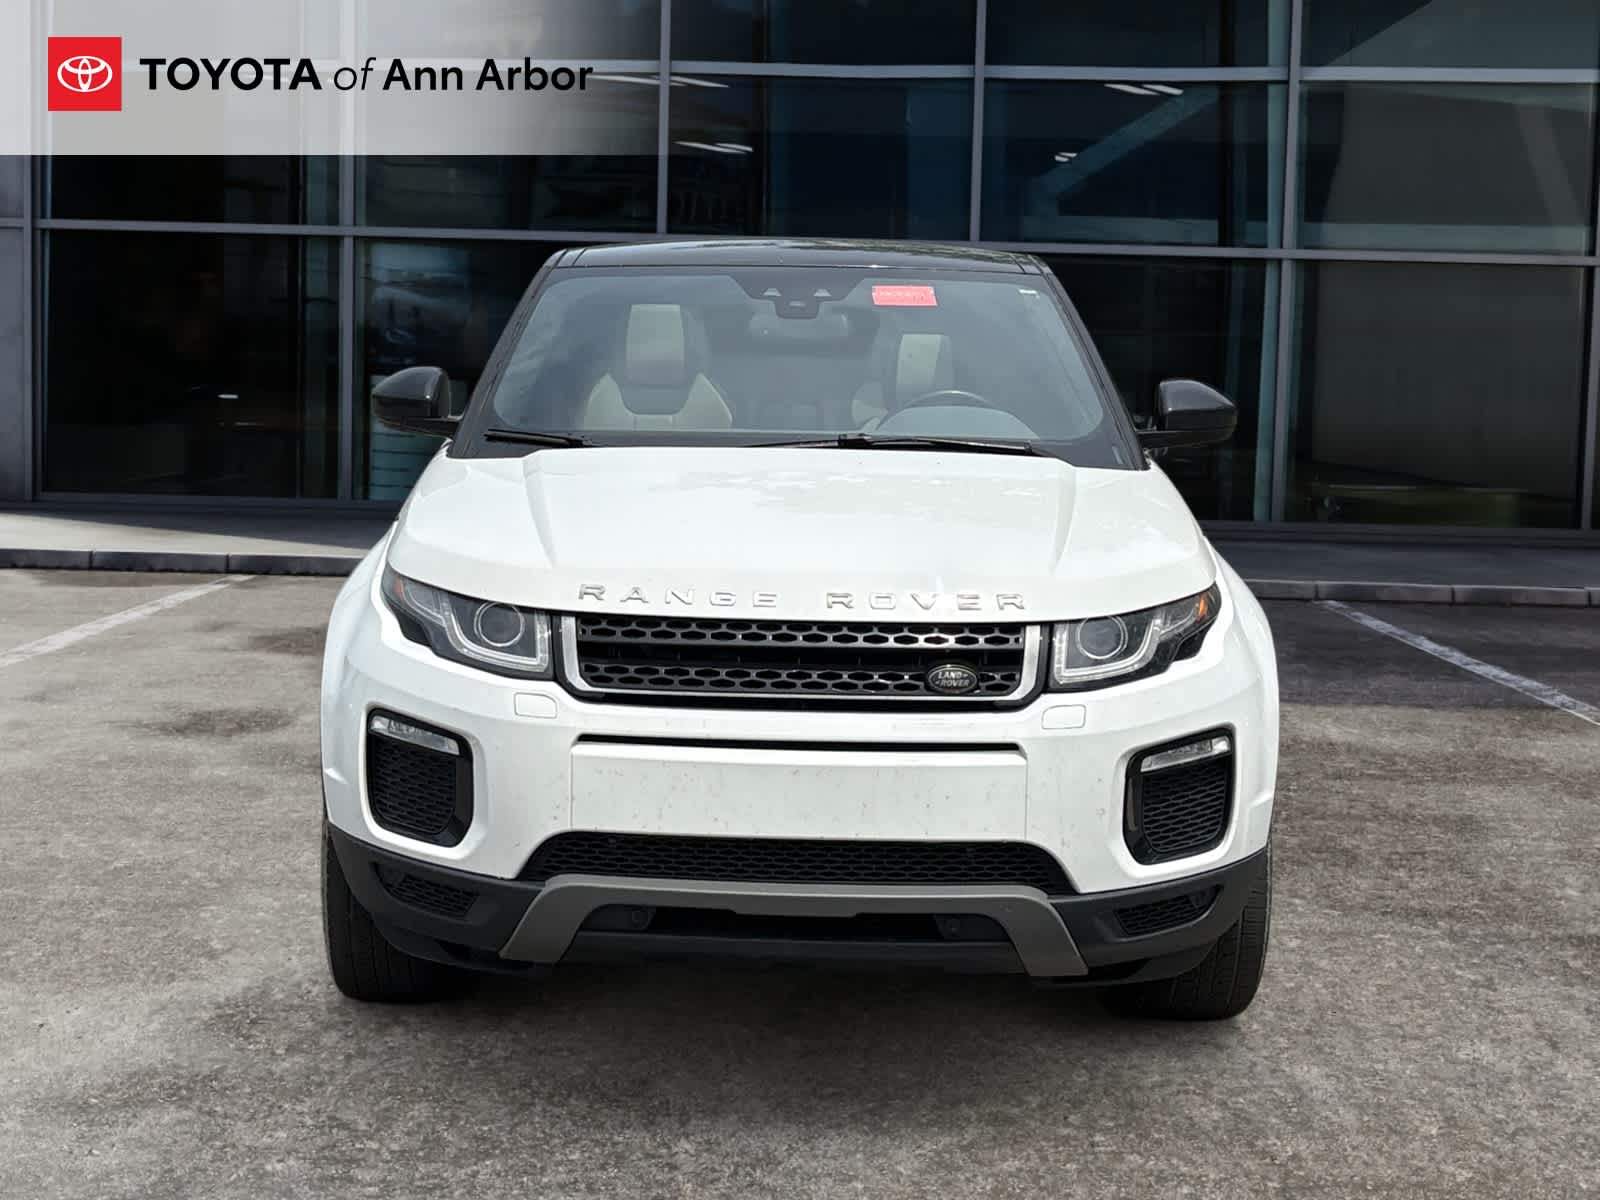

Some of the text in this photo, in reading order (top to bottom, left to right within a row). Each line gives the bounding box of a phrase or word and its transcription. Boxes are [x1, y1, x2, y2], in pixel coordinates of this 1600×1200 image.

[578, 583, 1026, 611] RANGE ROVER
[938, 671, 962, 679] LAND
[940, 679, 969, 687] ROVER
